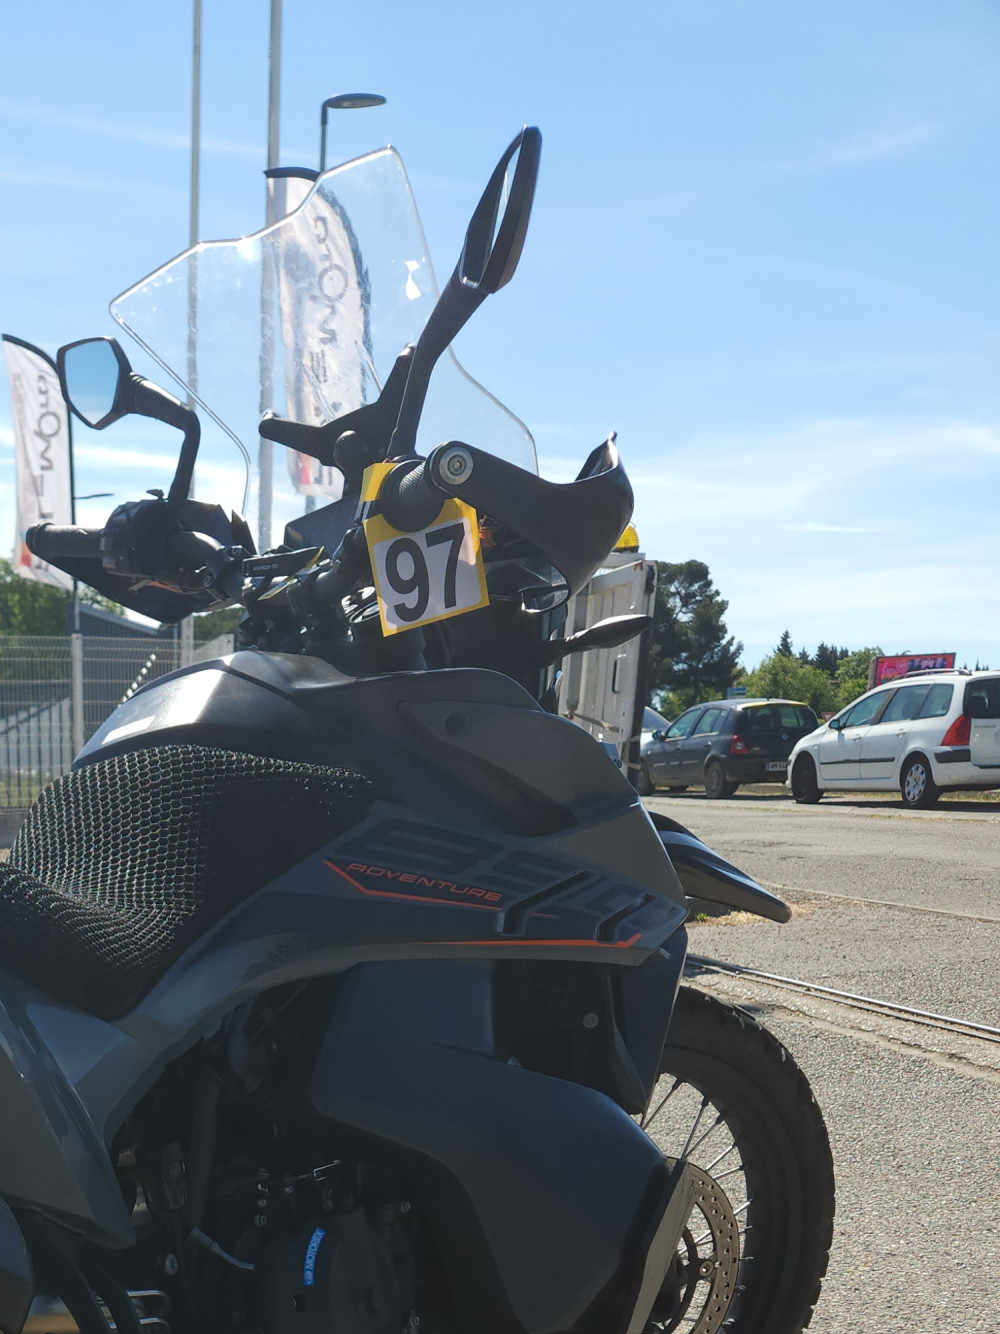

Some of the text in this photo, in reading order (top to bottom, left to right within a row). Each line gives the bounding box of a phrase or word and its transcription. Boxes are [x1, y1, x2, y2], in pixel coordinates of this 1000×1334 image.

[385, 522, 465, 622] 97
[345, 862, 504, 902] ADVENTURE
[305, 1231, 325, 1270] MOTOREX
